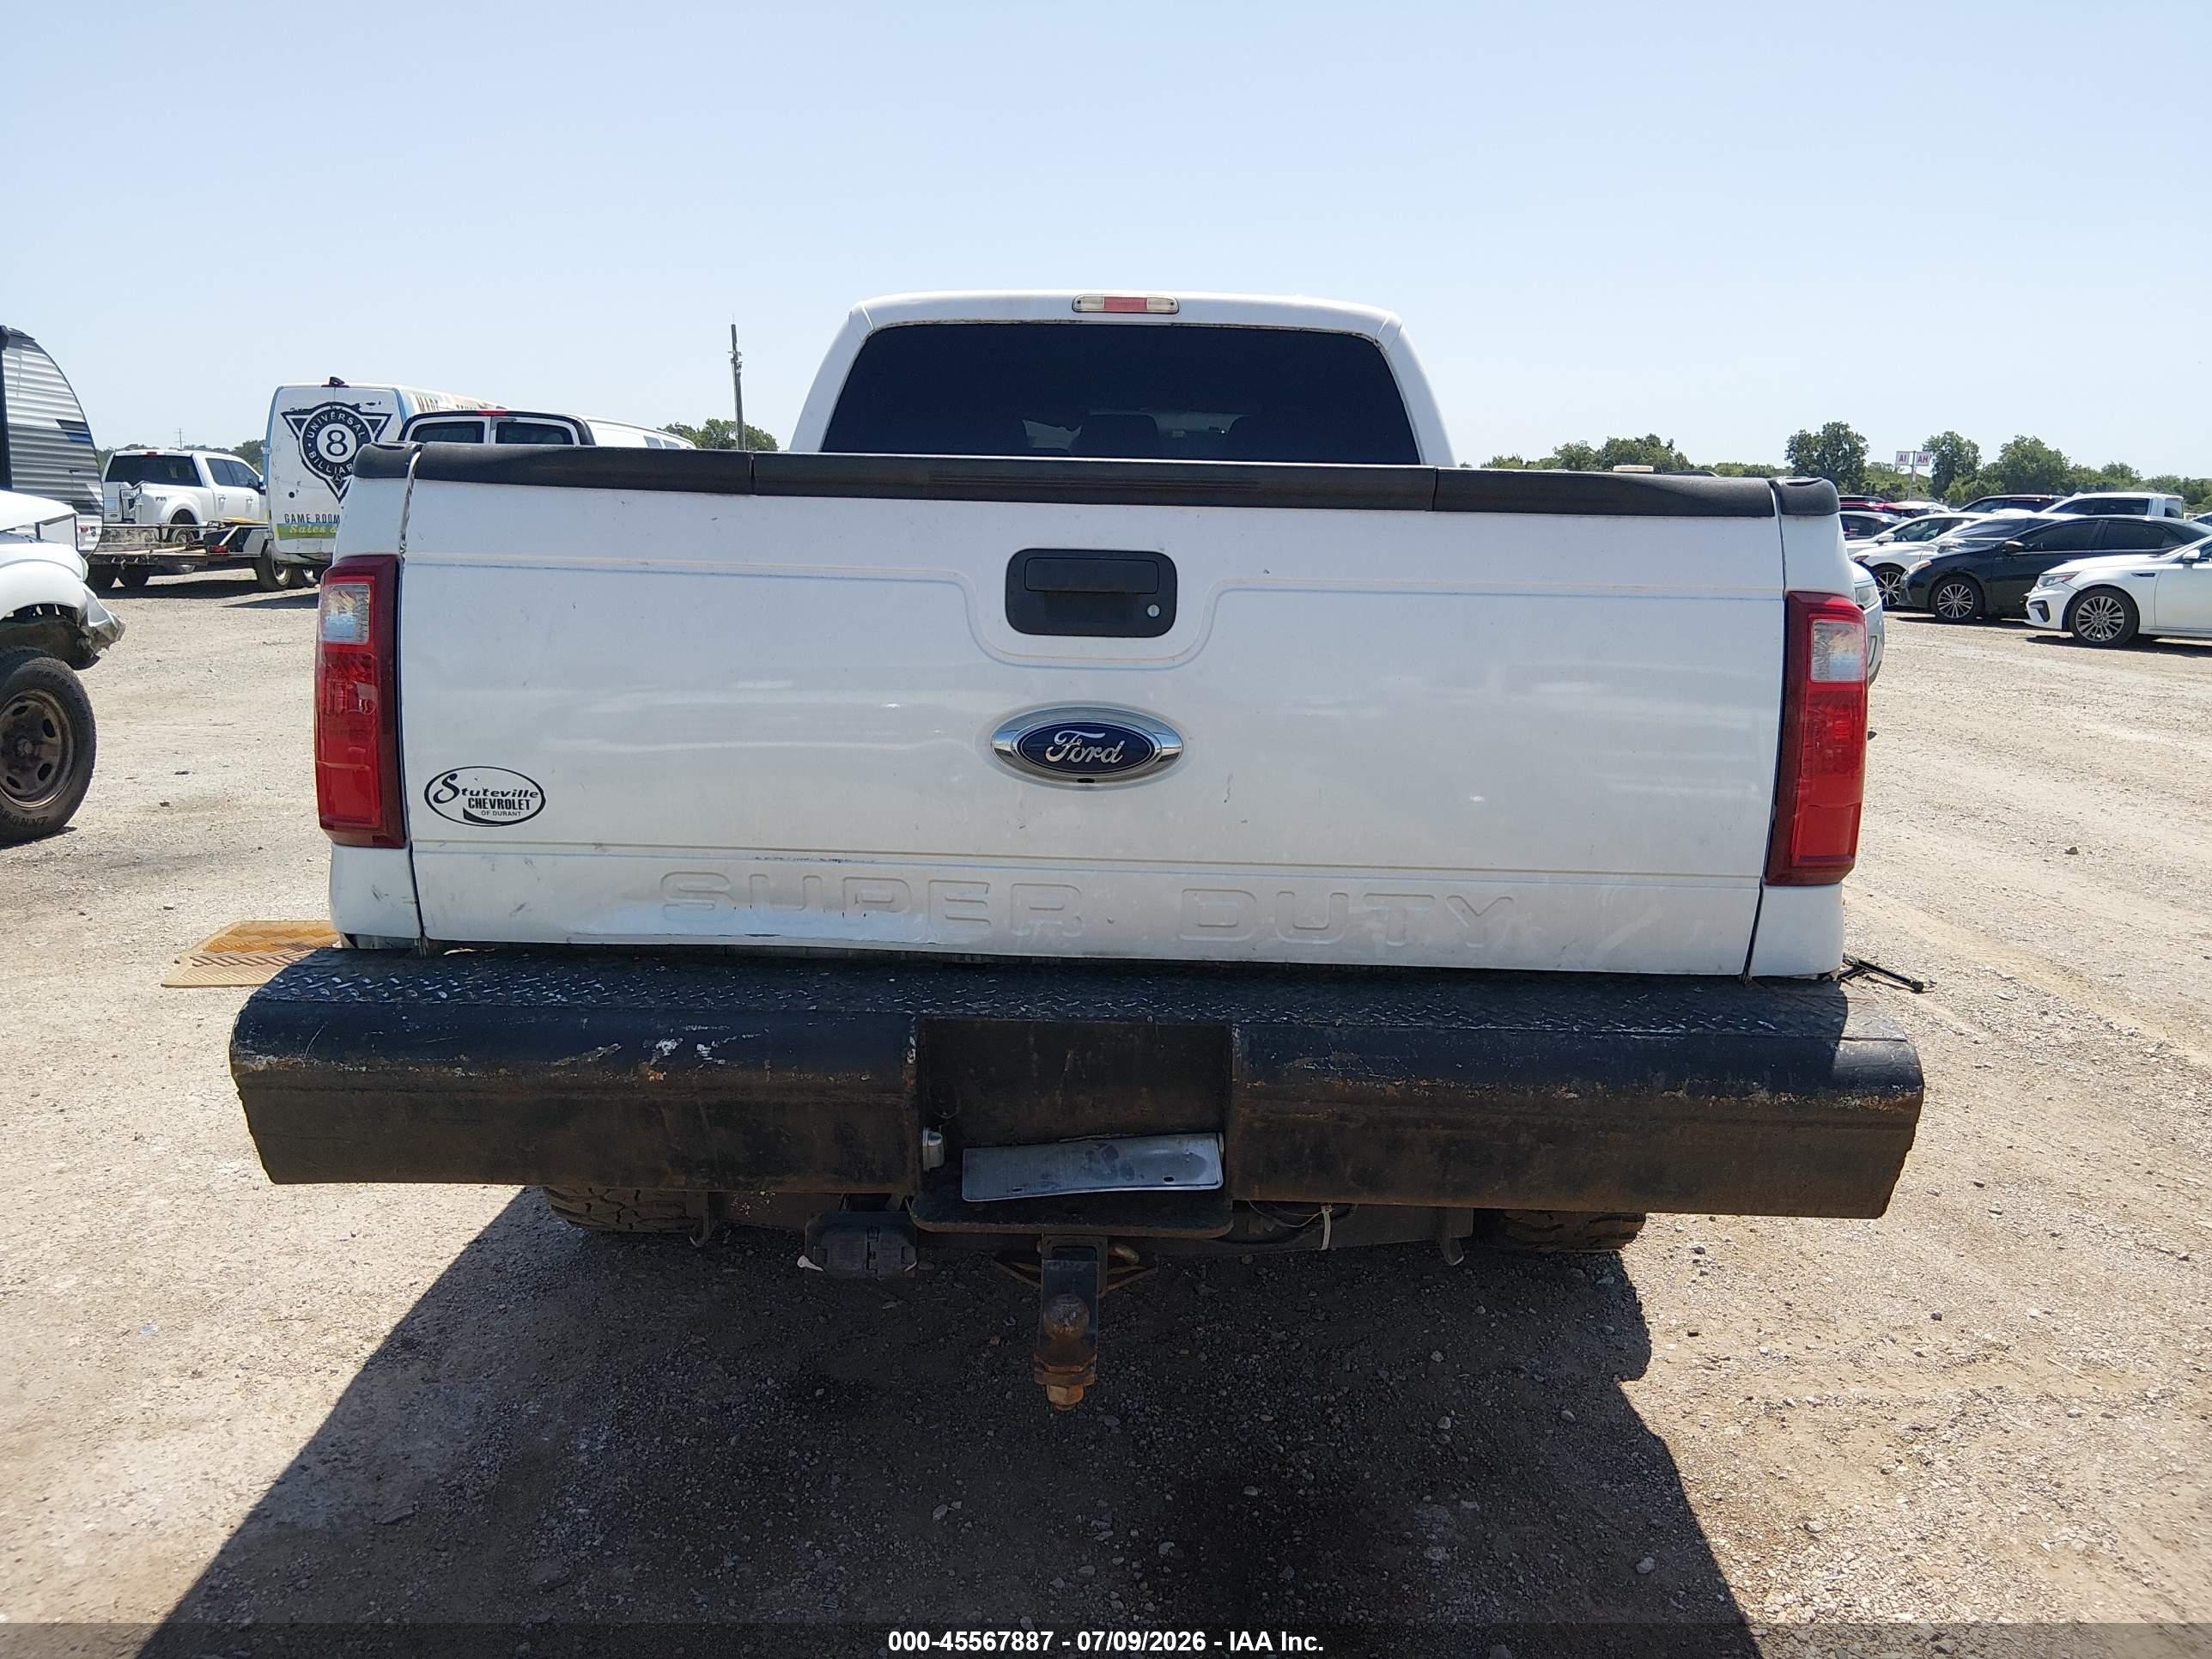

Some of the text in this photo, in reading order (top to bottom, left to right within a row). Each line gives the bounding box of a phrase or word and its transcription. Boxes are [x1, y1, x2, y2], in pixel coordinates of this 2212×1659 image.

[307, 412, 366, 439] UNIVERSAL
[325, 429, 348, 457] 8
[308, 450, 354, 474] BILLIAR
[1917, 455, 1929, 464] AH
[284, 514, 341, 524] GAME ROOM
[289, 524, 326, 534] Sales
[1045, 730, 1126, 763] Ford
[433, 773, 539, 805] Stuteville
[467, 797, 531, 811] CHEVROLET
[659, 871, 1515, 948] SUPER DUTY
